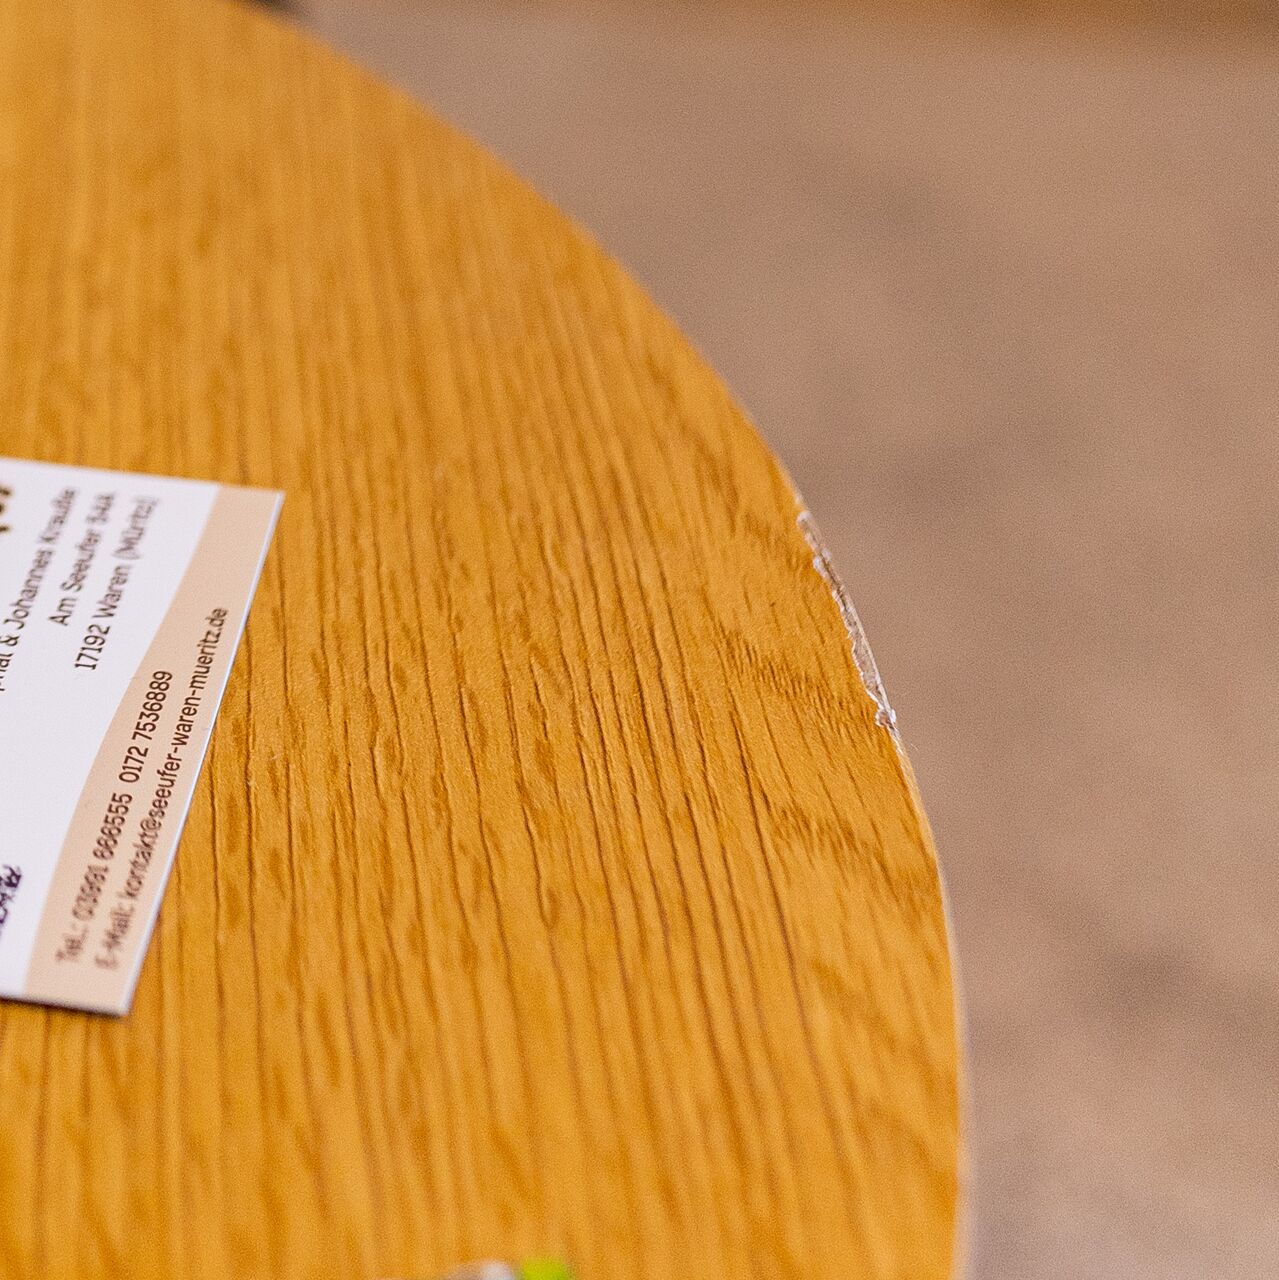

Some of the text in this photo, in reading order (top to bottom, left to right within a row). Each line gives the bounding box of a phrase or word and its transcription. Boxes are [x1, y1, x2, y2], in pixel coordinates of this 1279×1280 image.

[4, 549, 52, 629] Johannes
[61, 529, 101, 592] Seeufer
[48, 597, 77, 625] Am
[74, 624, 110, 670] 17192
[92, 564, 132, 618] Waren
[132, 669, 173, 740] 7536889
[116, 607, 228, 899] kontakt@seeufer-waren-mueritz.de
[119, 746, 150, 782] 0172
[92, 792, 133, 859] 666555
